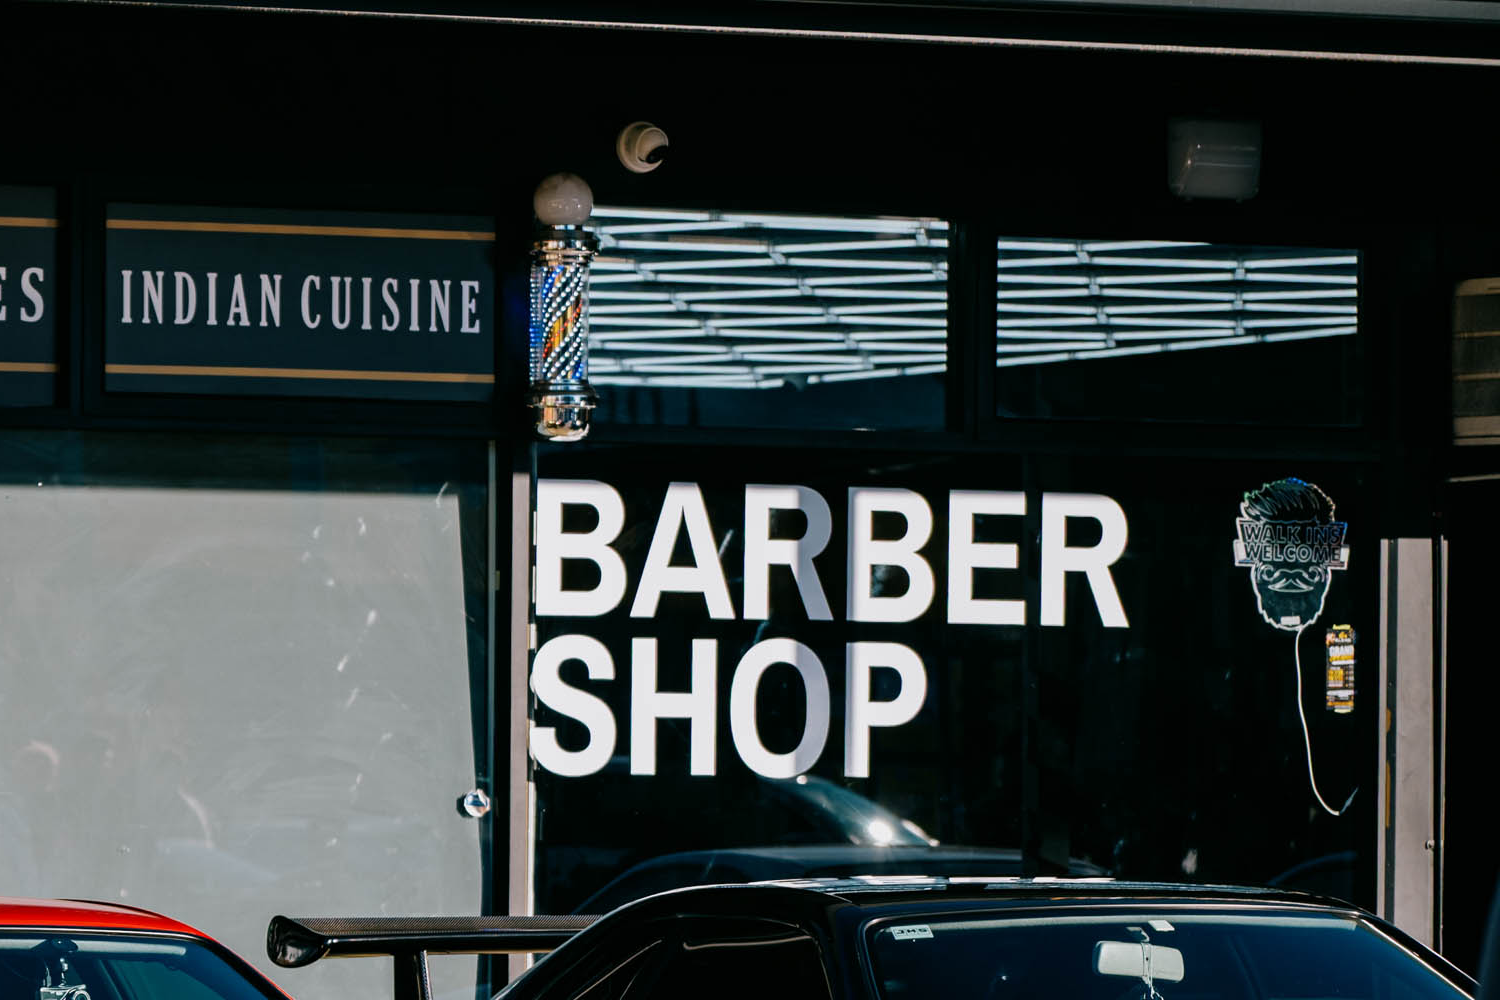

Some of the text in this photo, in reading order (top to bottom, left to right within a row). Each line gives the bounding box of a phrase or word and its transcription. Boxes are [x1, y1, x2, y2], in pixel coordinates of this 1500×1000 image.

[121, 269, 481, 334] INDIAN CUISINE
[534, 478, 1130, 628] BARBER
[1243, 525, 1341, 545] WALK INS
[1244, 544, 1341, 564] WELCOME
[530, 633, 928, 779] SHOP
